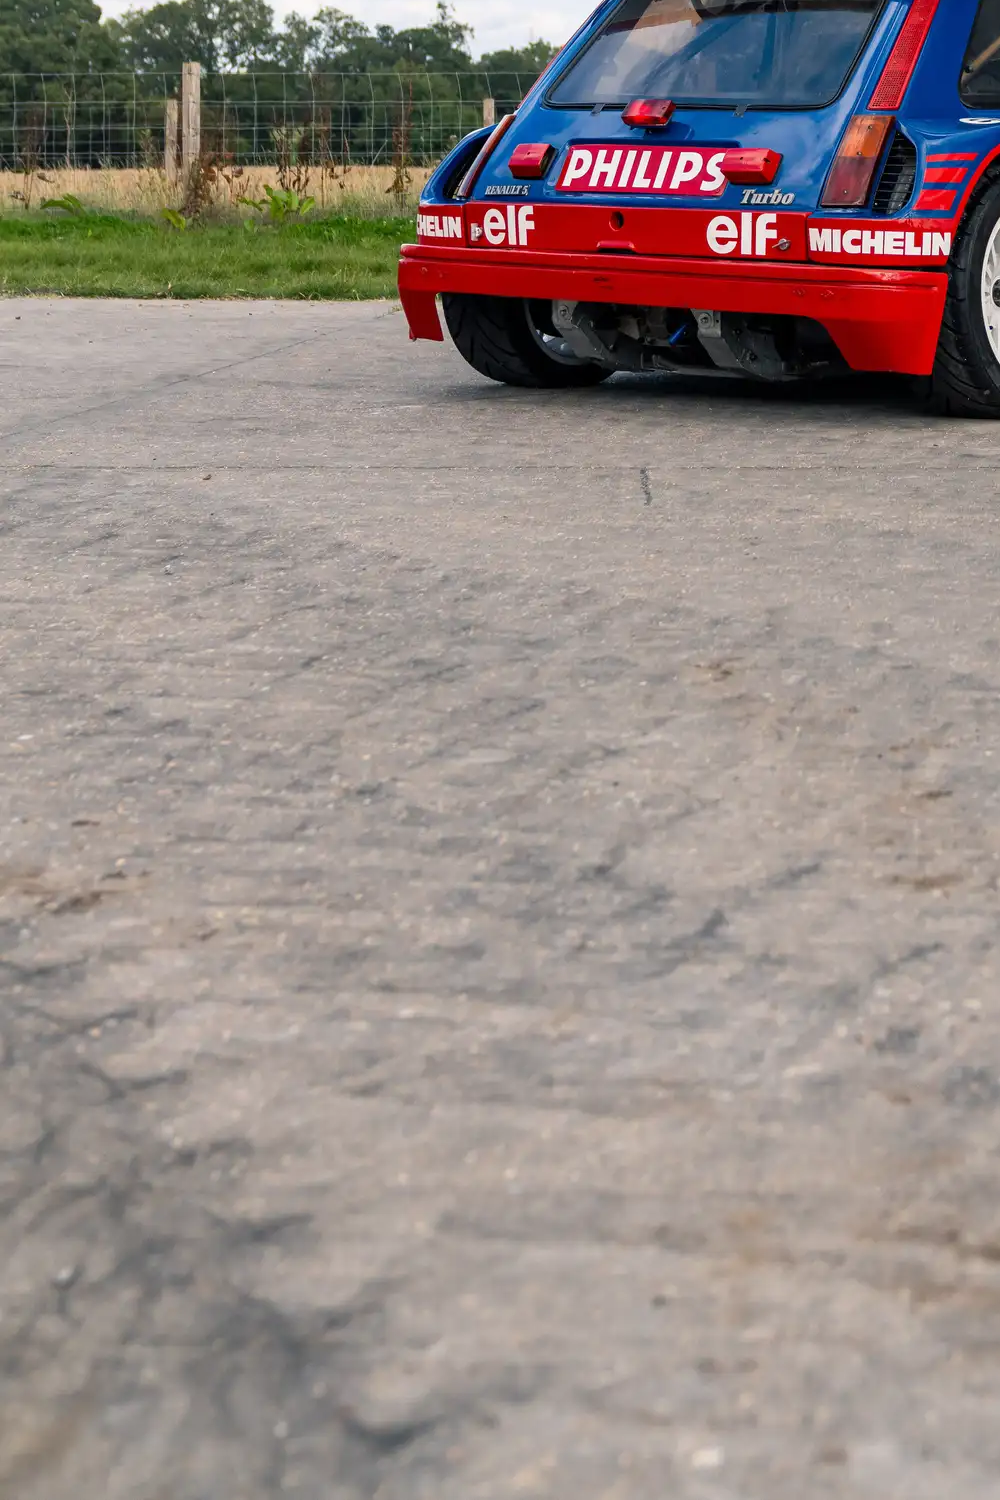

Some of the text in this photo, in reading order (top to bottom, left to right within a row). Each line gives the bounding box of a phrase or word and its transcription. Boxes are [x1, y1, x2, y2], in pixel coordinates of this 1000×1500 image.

[561, 149, 727, 192] PHILIPS
[485, 185, 523, 196] RENAULT
[740, 189, 794, 205] Turbo
[483, 205, 535, 246] elf
[706, 212, 778, 256] elf
[808, 228, 951, 256] MICHELIN
